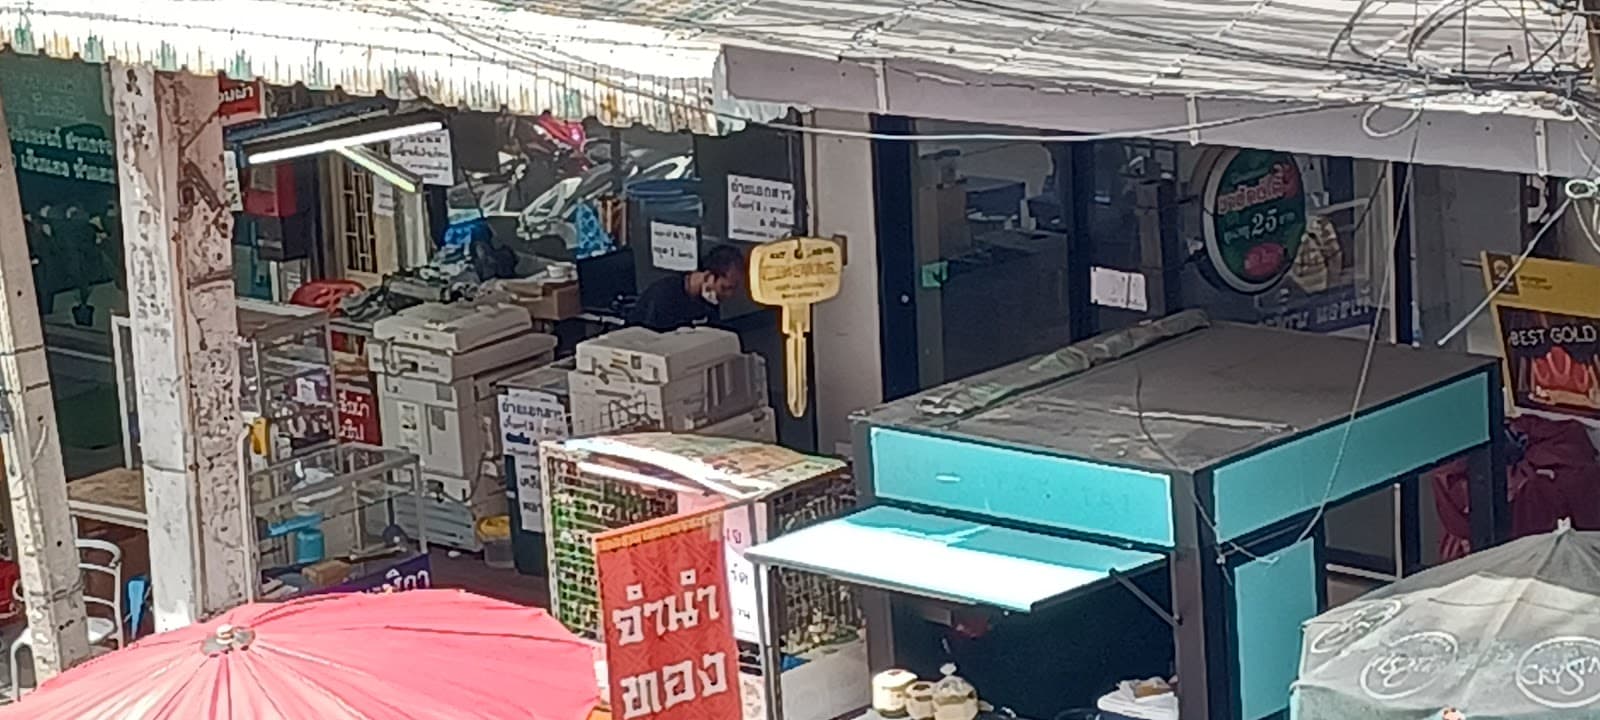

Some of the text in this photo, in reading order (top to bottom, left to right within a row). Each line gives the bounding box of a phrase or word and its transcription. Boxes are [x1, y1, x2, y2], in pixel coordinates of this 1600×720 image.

[1251, 208, 1278, 238] 25
[1510, 325, 1598, 346] BEST GOLD
[612, 569, 720, 646] จำนำ
[620, 652, 728, 720] ทอง
